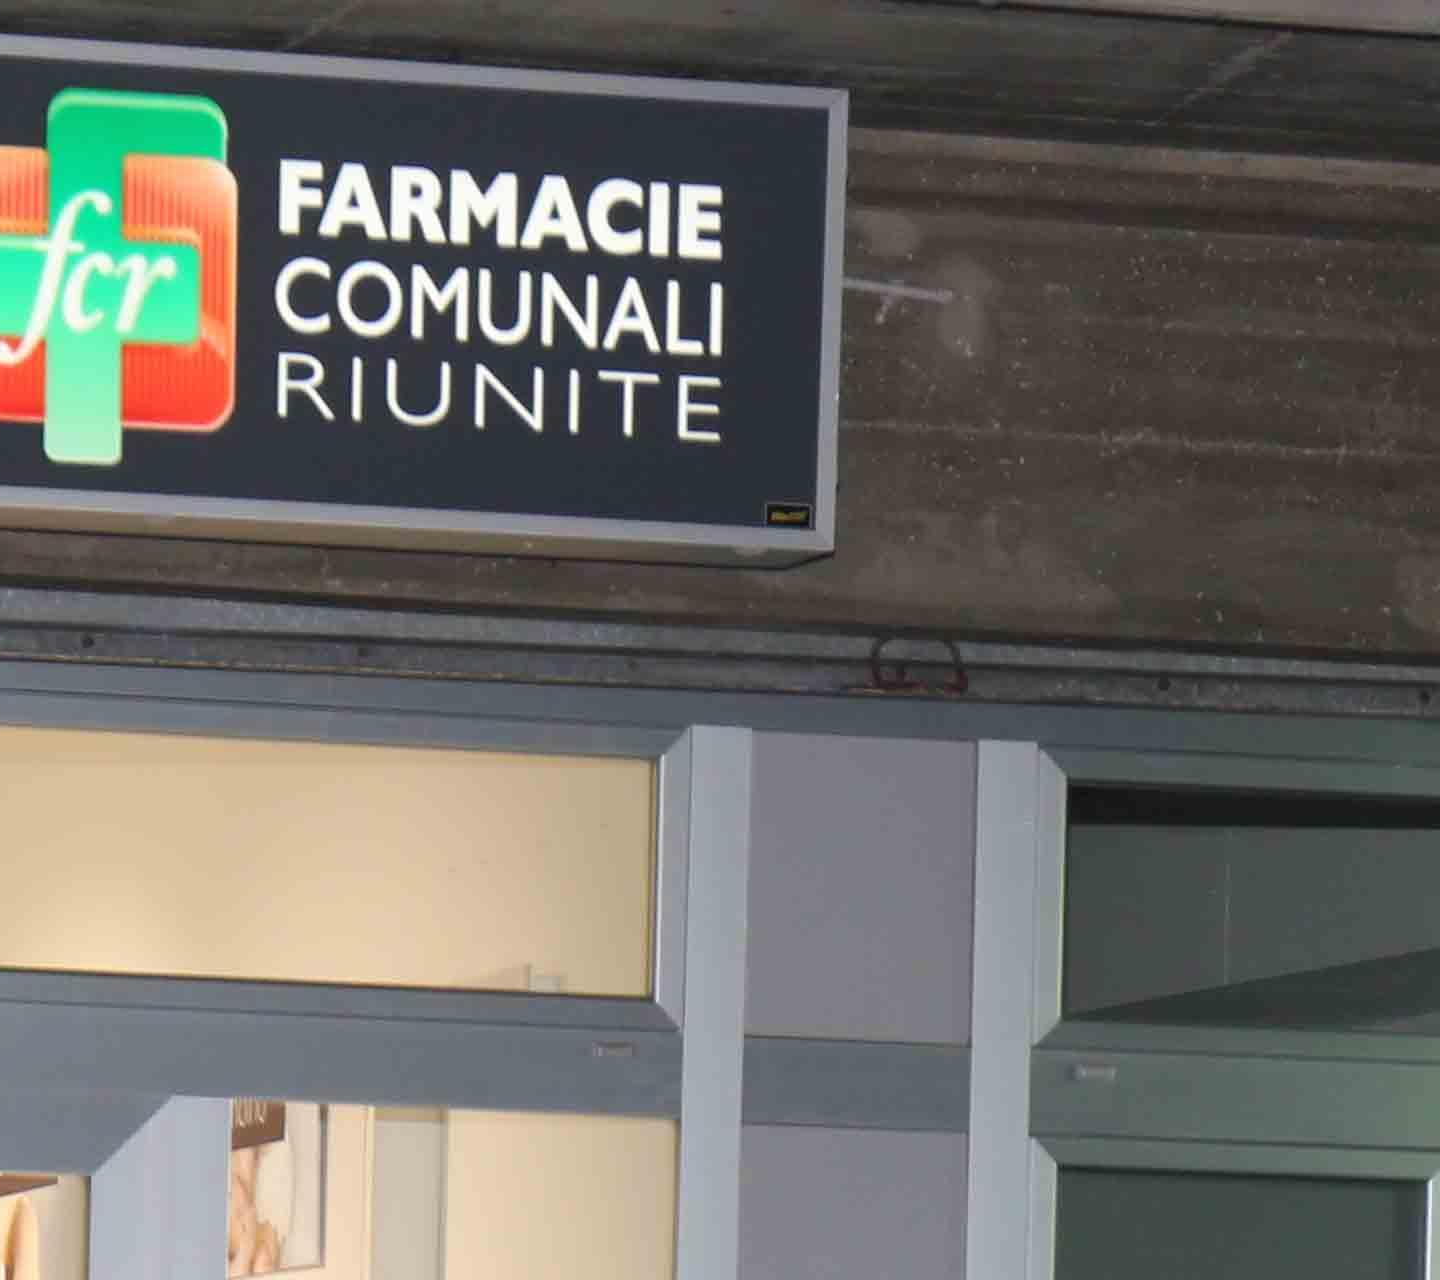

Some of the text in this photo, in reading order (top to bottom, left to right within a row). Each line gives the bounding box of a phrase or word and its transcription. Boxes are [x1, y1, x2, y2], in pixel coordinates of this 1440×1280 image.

[277, 158, 724, 260] FARMACIE
[274, 257, 724, 357] COMUNALI
[275, 352, 722, 443] RIUNITE
